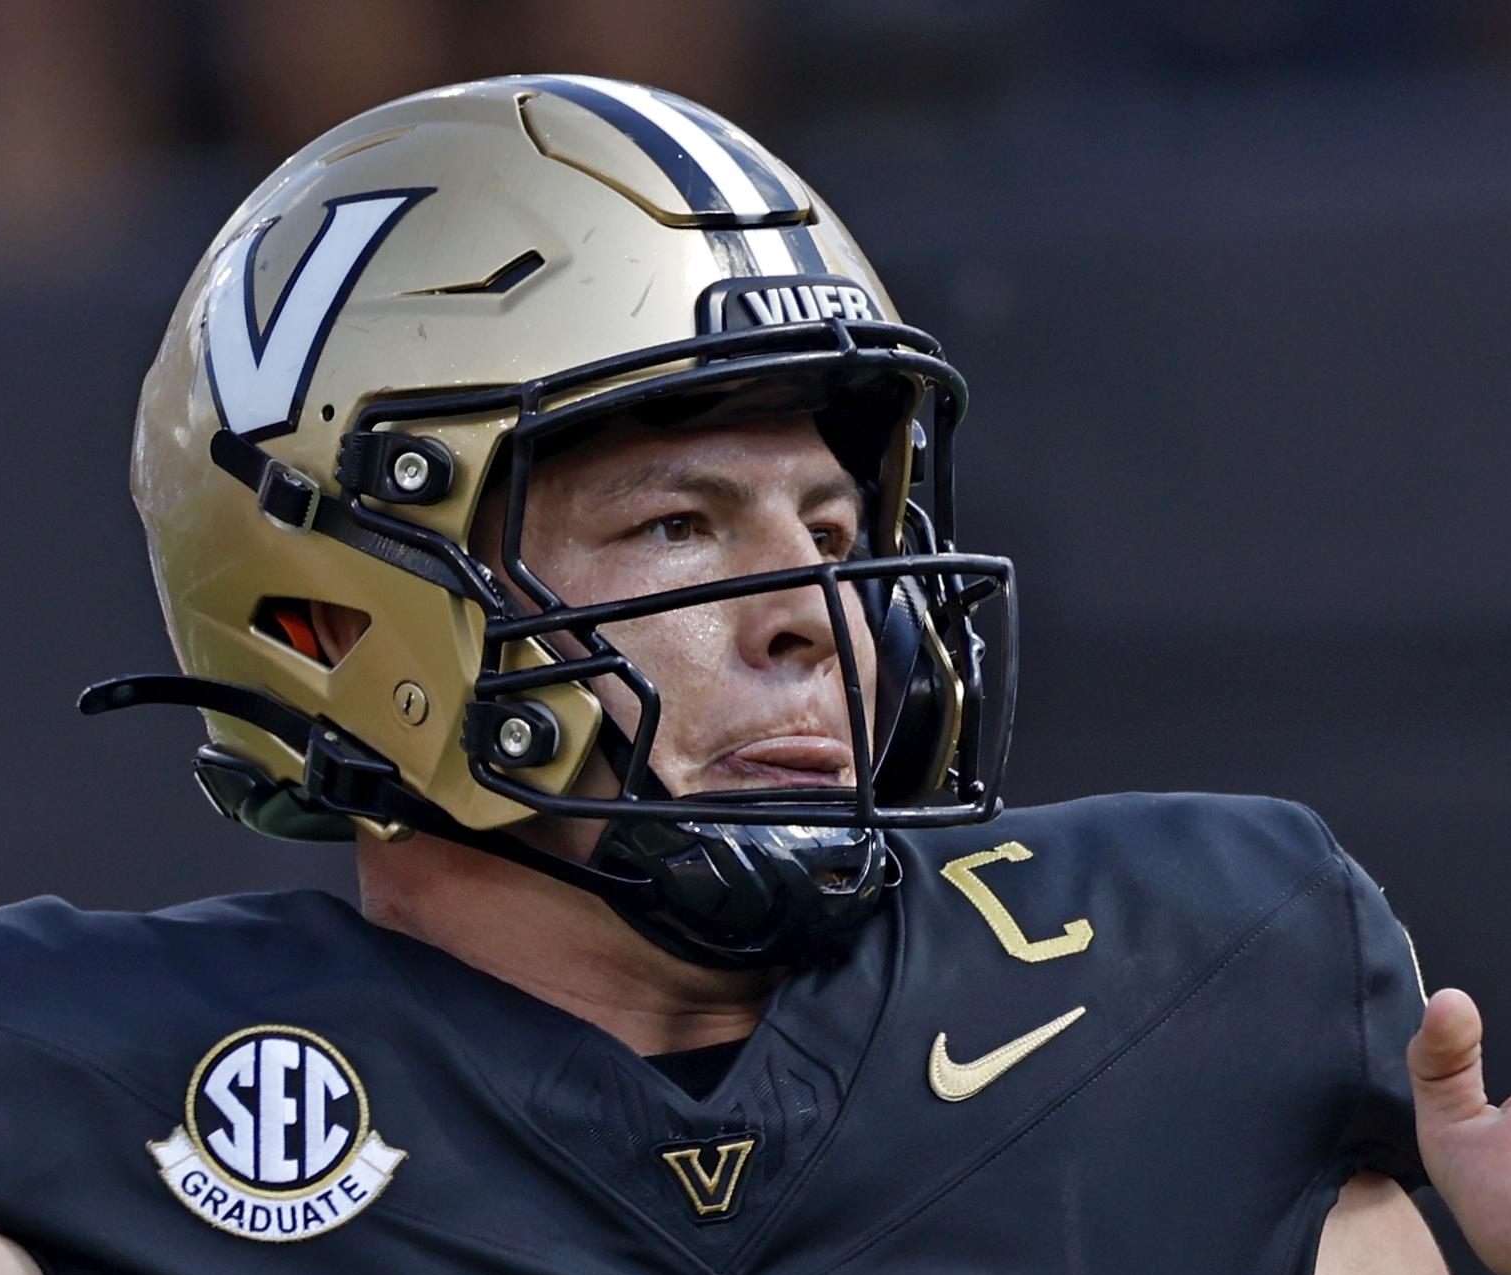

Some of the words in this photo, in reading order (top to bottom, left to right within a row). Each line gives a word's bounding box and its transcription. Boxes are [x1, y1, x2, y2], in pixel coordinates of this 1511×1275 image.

[939, 840, 1095, 963] C
[203, 1037, 351, 1184] SEC
[181, 1170, 369, 1234] GRADUATE
[662, 1139, 755, 1216] V
